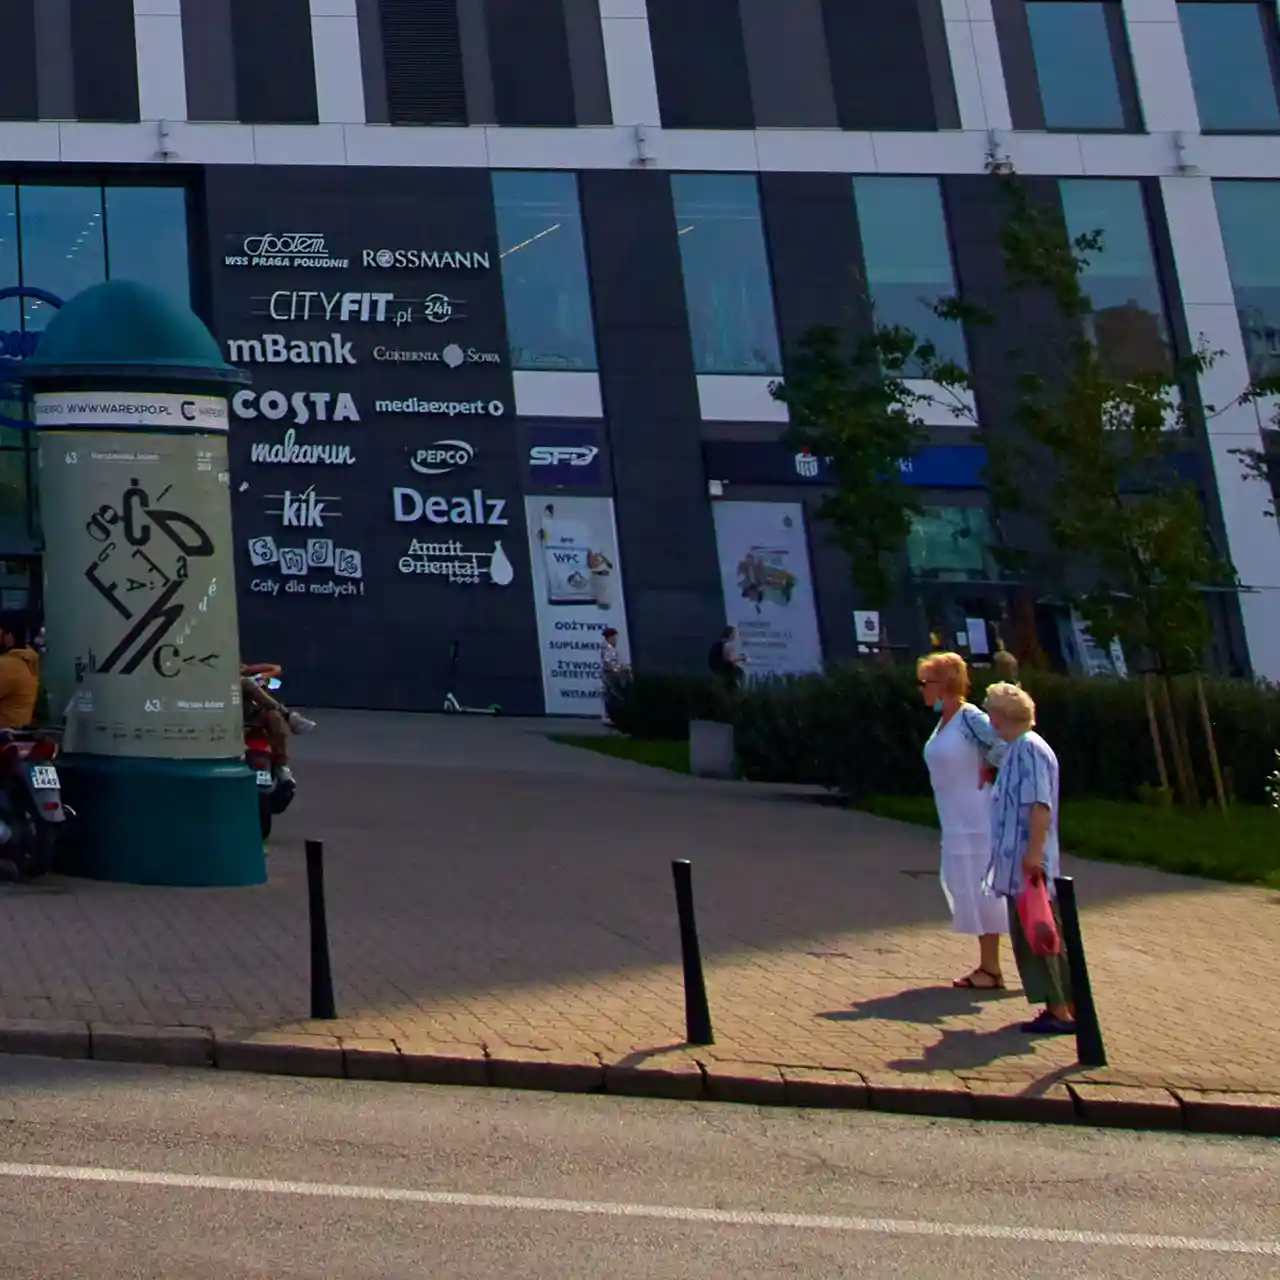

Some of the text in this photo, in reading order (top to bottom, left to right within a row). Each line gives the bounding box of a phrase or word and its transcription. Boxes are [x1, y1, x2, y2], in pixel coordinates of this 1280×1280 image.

[225, 256, 350, 269] WSS PRAGA POŁUDNIE
[363, 251, 491, 270] ROSSMANN
[227, 333, 357, 365] mBank
[232, 389, 361, 423] COSTA
[375, 397, 486, 416] mediaexpert
[251, 429, 356, 466] makarun
[416, 449, 468, 465] PEPCO
[282, 485, 325, 528] kik
[393, 486, 509, 526] Dealz
[407, 538, 463, 555] Amrit
[398, 554, 480, 576] Oriental
[285, 579, 306, 593] dla
